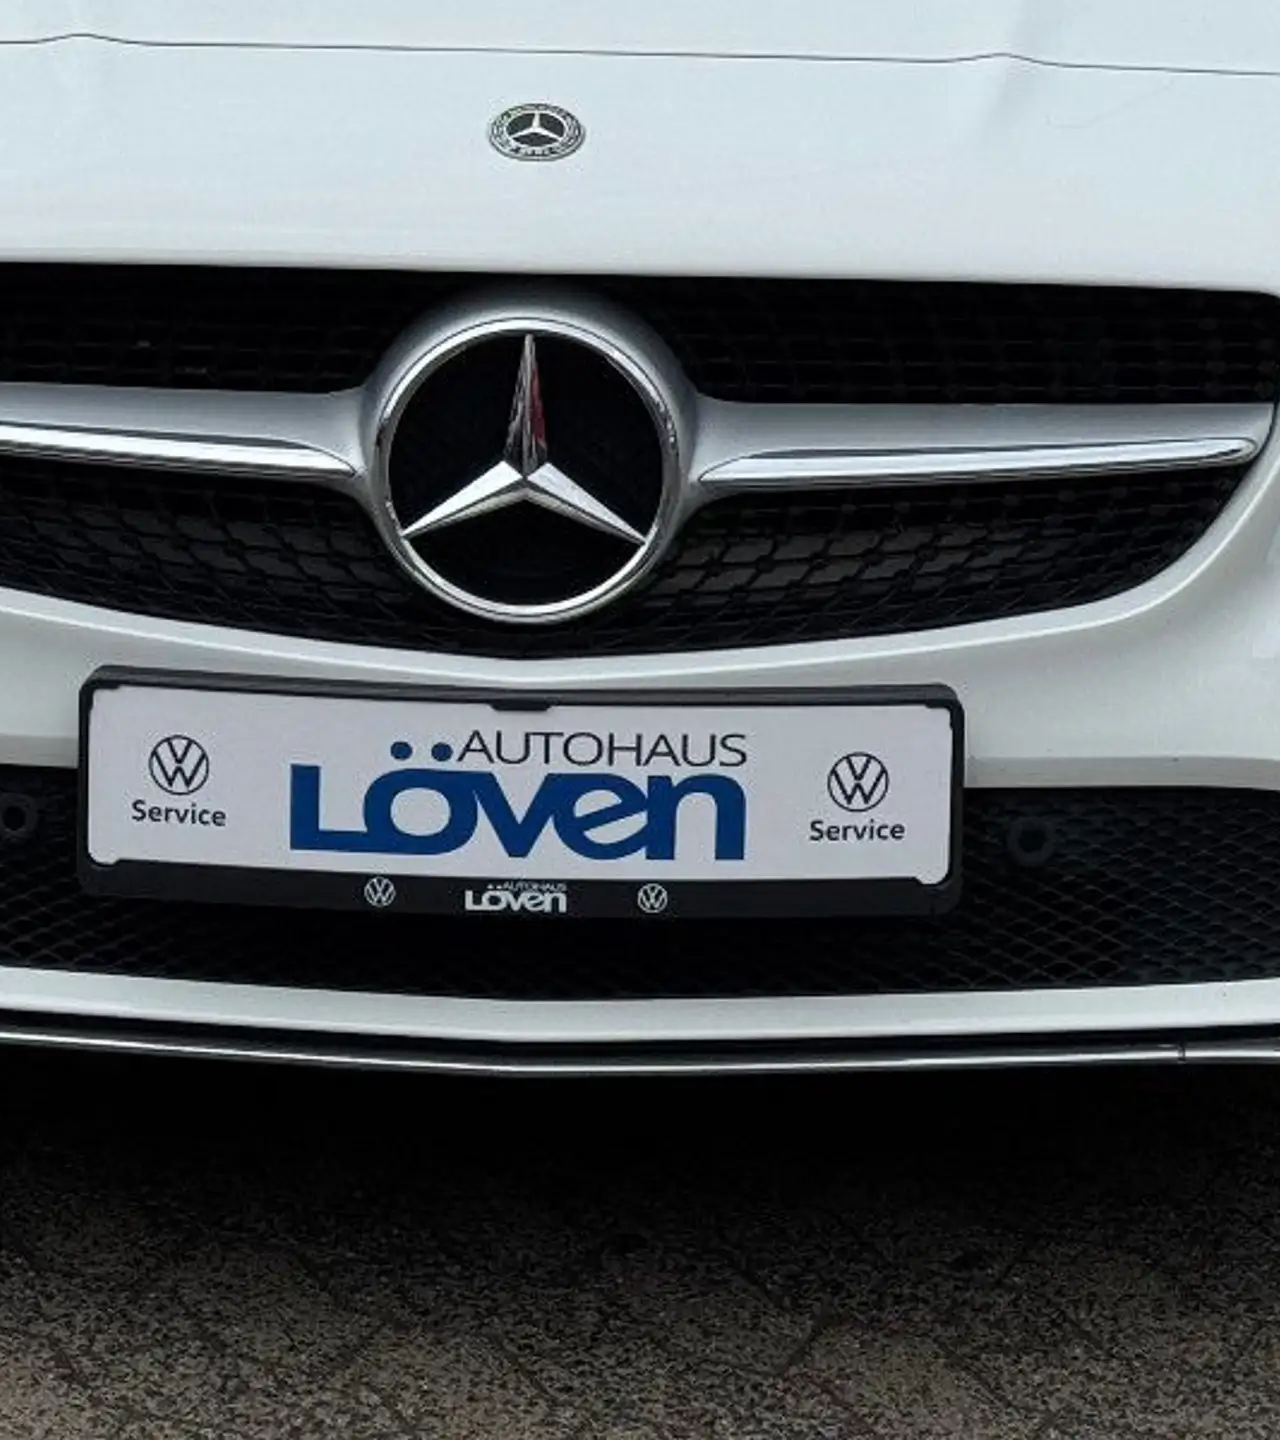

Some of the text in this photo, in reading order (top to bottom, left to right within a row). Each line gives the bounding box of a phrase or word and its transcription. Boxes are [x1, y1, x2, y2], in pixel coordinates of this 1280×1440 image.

[457, 729, 748, 768] AUTOHAUS
[131, 799, 226, 827] Service
[290, 741, 747, 861] Löven
[809, 818, 905, 841] Service
[465, 883, 568, 913] Löven
